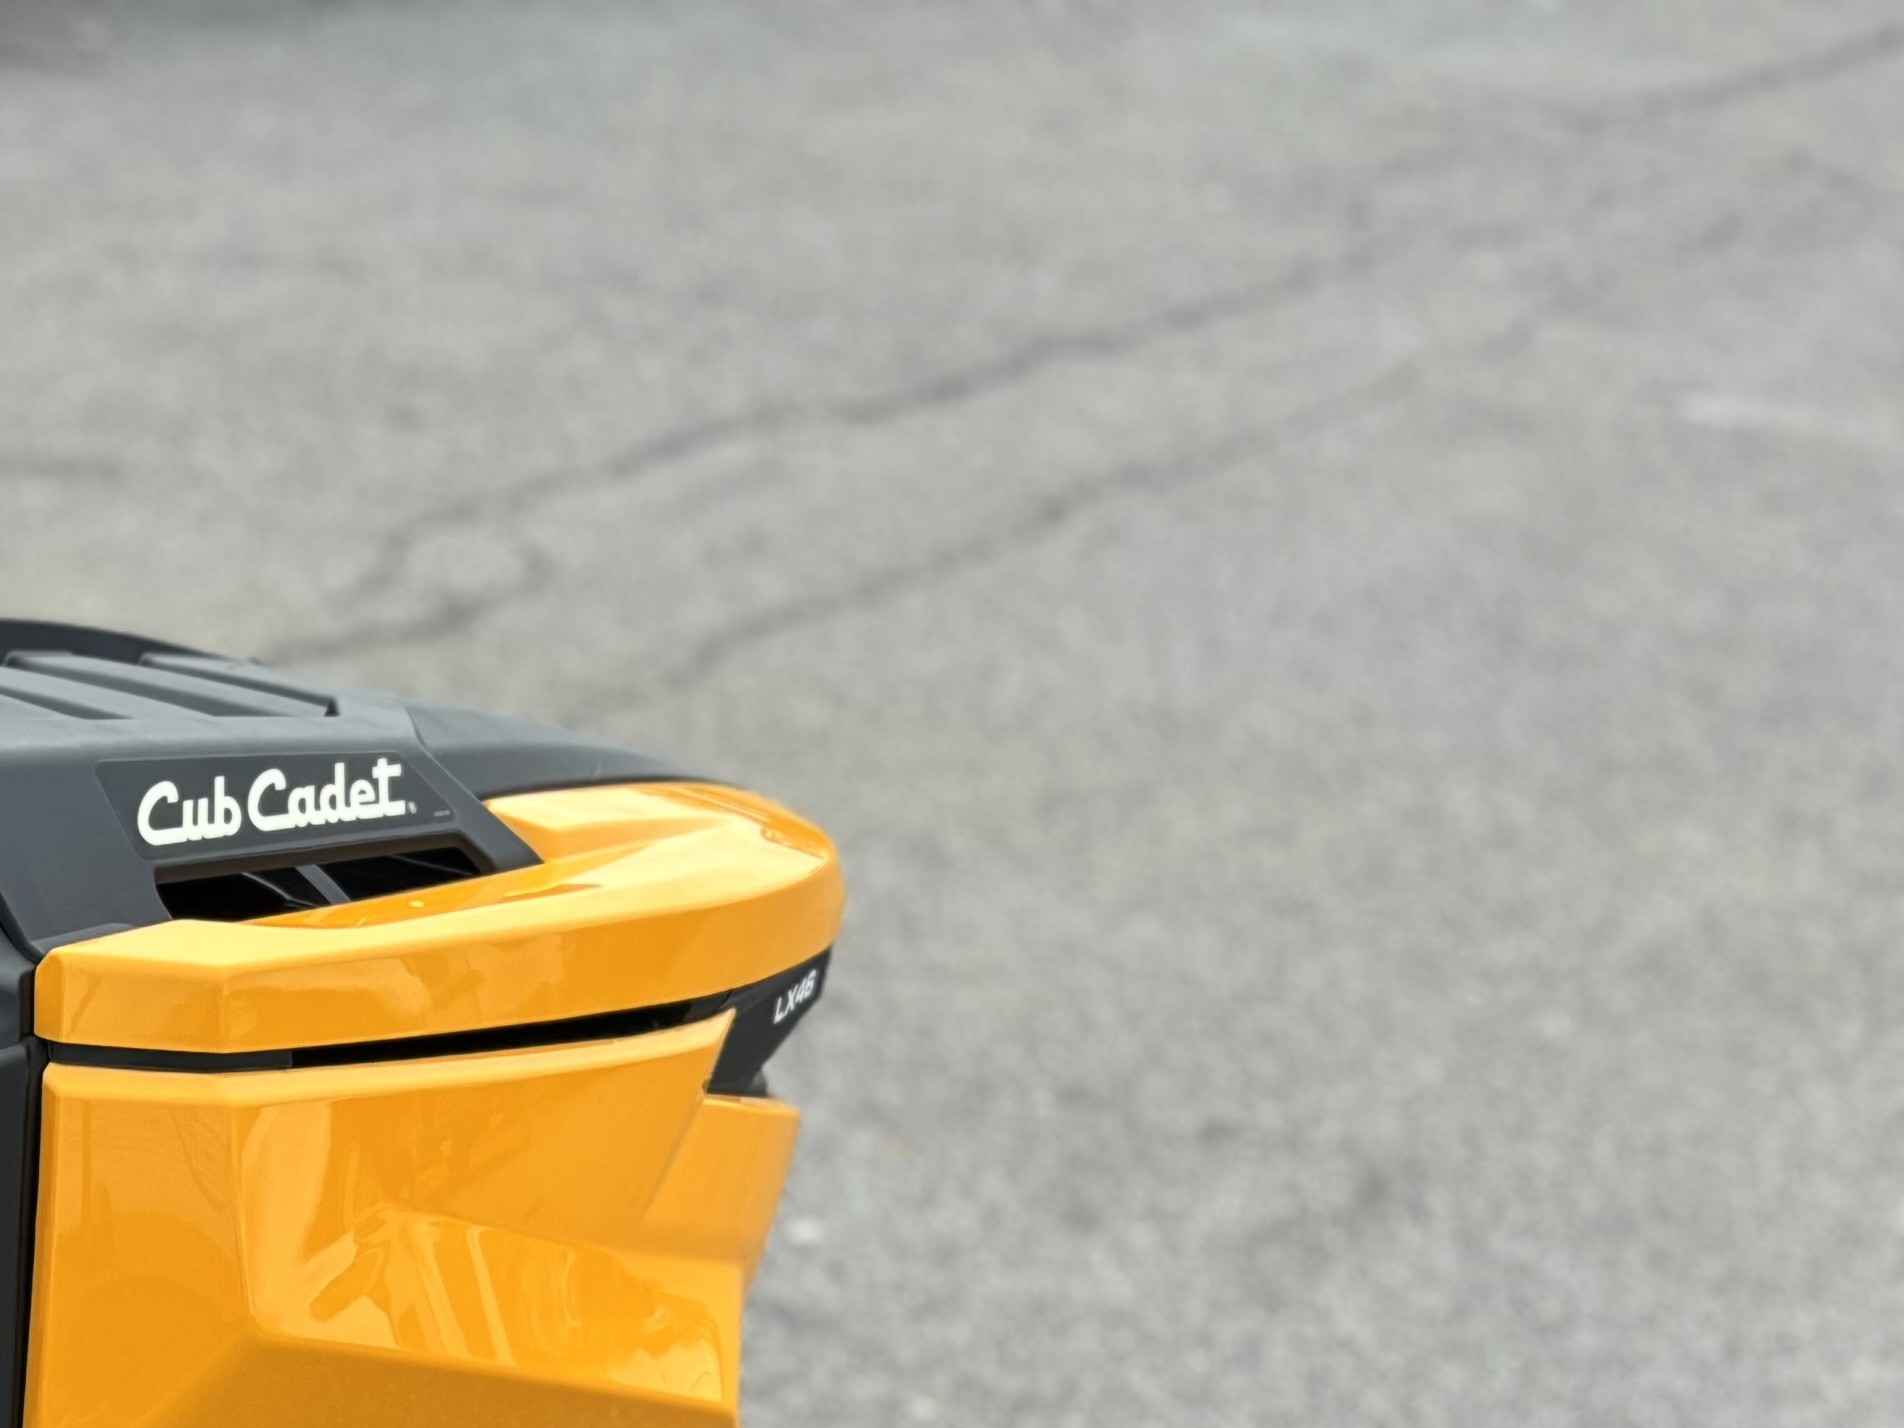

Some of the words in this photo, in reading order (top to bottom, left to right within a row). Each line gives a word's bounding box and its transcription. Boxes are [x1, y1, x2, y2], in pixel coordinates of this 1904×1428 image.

[137, 775, 243, 847] Cub
[247, 757, 406, 832] Cadet
[773, 968, 817, 1024] LX46
